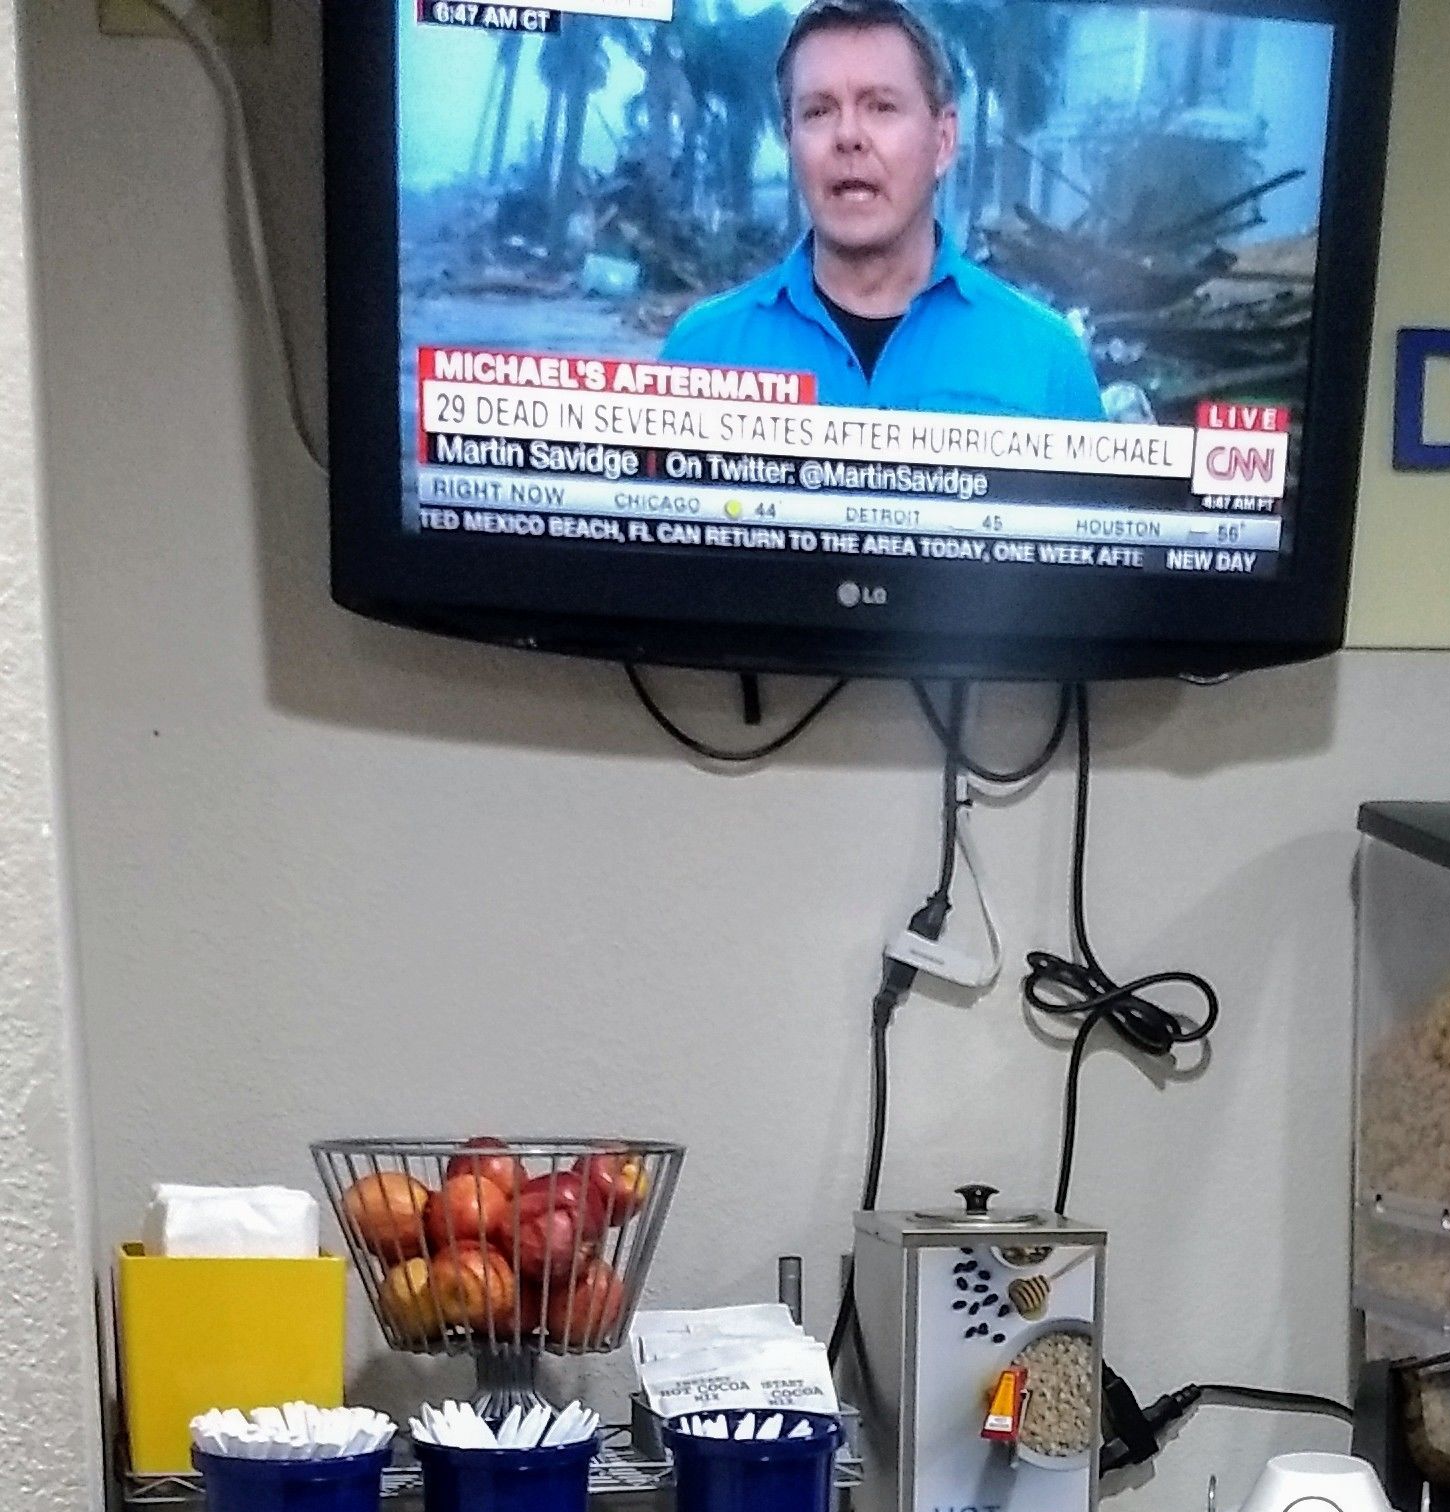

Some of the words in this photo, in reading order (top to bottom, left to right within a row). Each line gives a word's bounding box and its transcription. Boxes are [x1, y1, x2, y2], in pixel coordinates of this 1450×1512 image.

[484, 3, 516, 29] AM
[521, 8, 550, 32] CT
[434, 350, 606, 390] MICHAEL'S
[613, 363, 799, 404] AFTERMATH
[437, 392, 466, 423] 29
[477, 396, 548, 428] DEAD
[560, 402, 583, 430] IN
[594, 404, 709, 440] SEVERAL
[720, 413, 813, 446] STATES
[824, 420, 901, 450] AFTER
[912, 425, 1053, 460] HURRICANE
[1066, 434, 1173, 467] MICHAEL
[1208, 404, 1277, 430] LIVE
[436, 434, 525, 468] Martin
[529, 440, 639, 480] Savidge
[665, 450, 702, 479] On
[800, 459, 988, 499] @MartinSavidge
[1206, 445, 1275, 482] CNN
[433, 477, 502, 500] RIGHT
[511, 483, 565, 507] NOW
[614, 492, 700, 514] CHICAGO
[846, 506, 920, 526] DETROIT
[1076, 518, 1161, 538] HOUSTON
[420, 508, 460, 530] TED
[463, 511, 546, 536] MEXICO
[547, 515, 626, 543] BEACH,
[656, 522, 701, 544] CAN
[704, 525, 785, 549] RETURN
[788, 529, 818, 551] TO
[820, 531, 860, 554] THE
[861, 534, 918, 557] AREA
[919, 536, 991, 563] TODAY,
[993, 541, 1036, 563] ONE
[1037, 543, 1095, 566] WEEK
[1165, 547, 1214, 571] NEW
[1214, 550, 1257, 573] DAY
[697, 1380, 751, 1394] COCOA
[771, 1386, 824, 1398] COCOA
